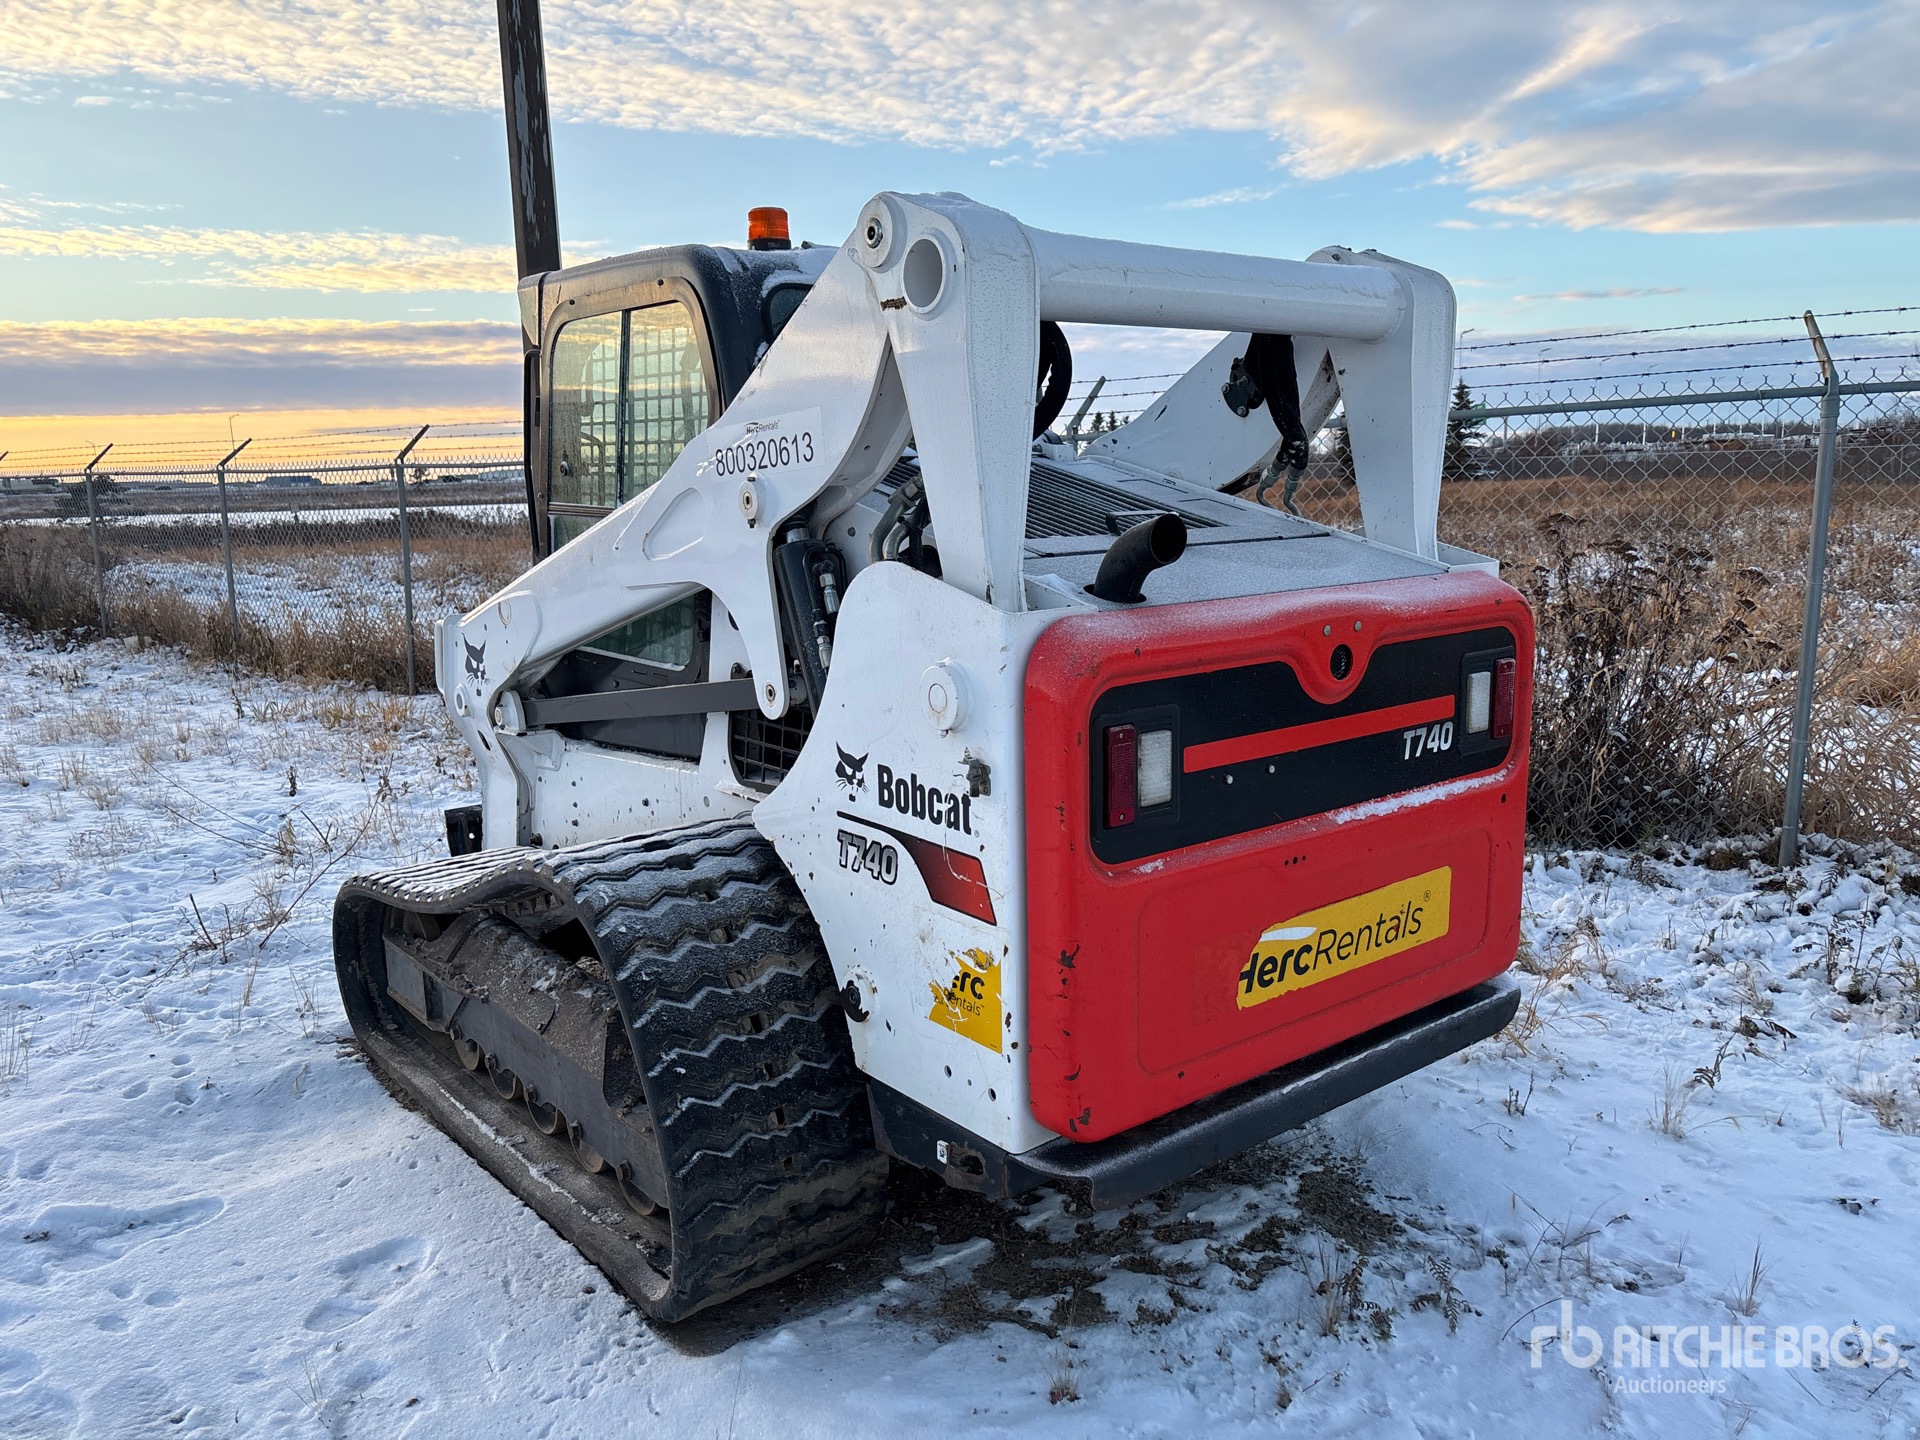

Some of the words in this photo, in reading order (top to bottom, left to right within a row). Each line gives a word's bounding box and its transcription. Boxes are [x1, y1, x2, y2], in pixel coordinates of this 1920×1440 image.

[716, 432, 814, 477] 800320613
[1403, 721, 1454, 760] T740
[877, 763, 972, 836] Bobcat
[837, 828, 899, 886] T740
